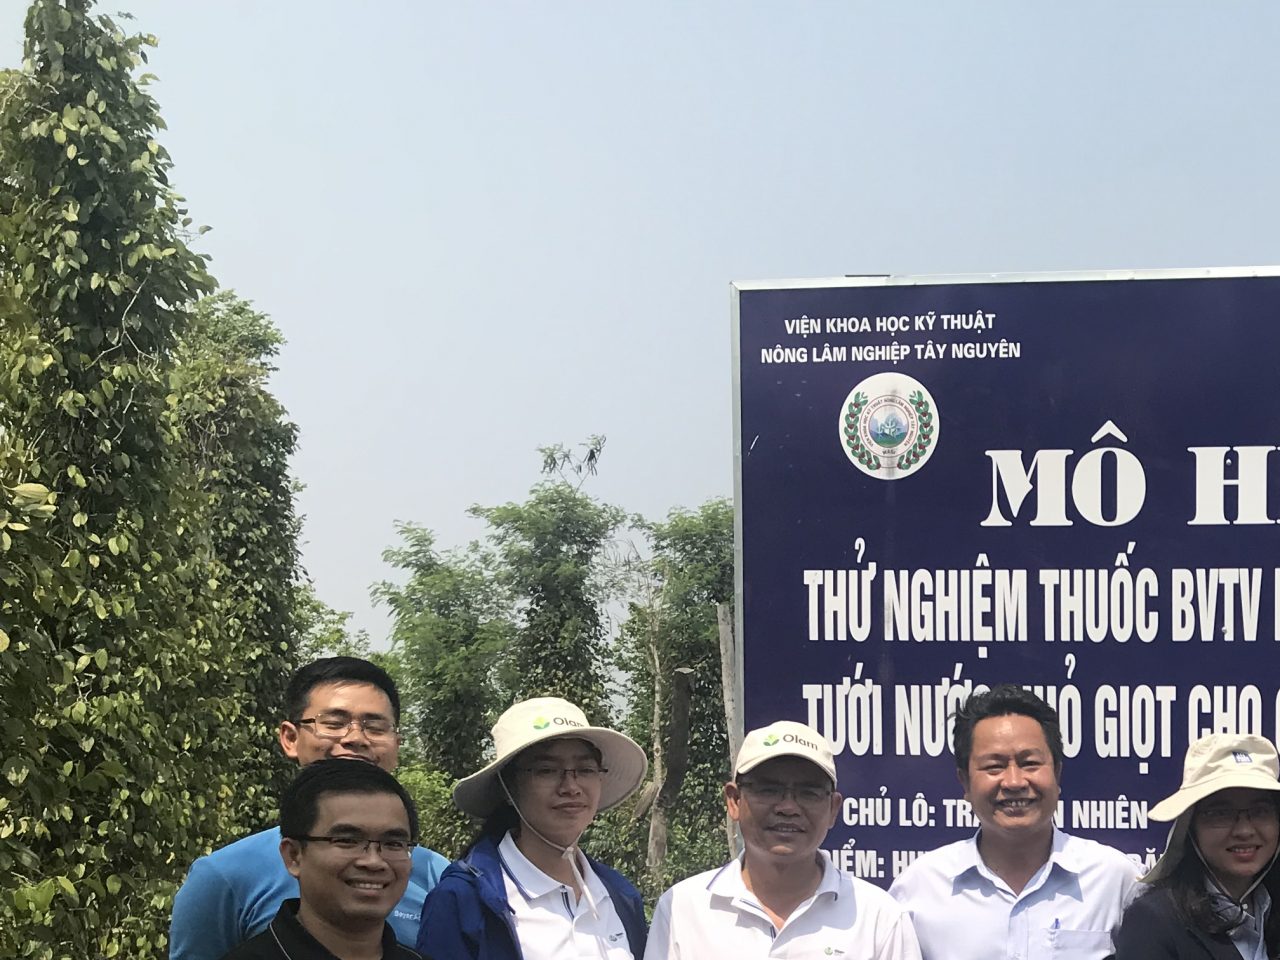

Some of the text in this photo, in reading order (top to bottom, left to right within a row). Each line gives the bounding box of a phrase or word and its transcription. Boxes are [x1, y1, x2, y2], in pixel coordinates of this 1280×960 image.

[784, 309, 996, 339] VIỆN KHOA HỌC KỸ THUẬT
[761, 338, 1021, 365] NÔNG LÂM NGHIỆP TÂY NGUYÊN
[980, 420, 1147, 527] MÔ
[803, 537, 877, 642] THỬ
[883, 553, 1028, 659] NGHIỆM
[1039, 541, 1159, 643] THUỐC
[1171, 567, 1263, 642] BVTV
[802, 662, 883, 756] TƯỚI
[1094, 684, 1177, 775] GIỌT
[1188, 684, 1262, 746] CHO
[782, 733, 819, 752] Olam
[842, 785, 892, 827] CHỦ
[898, 792, 936, 827] LÔ:
[1072, 794, 1148, 829] NHIÊN
